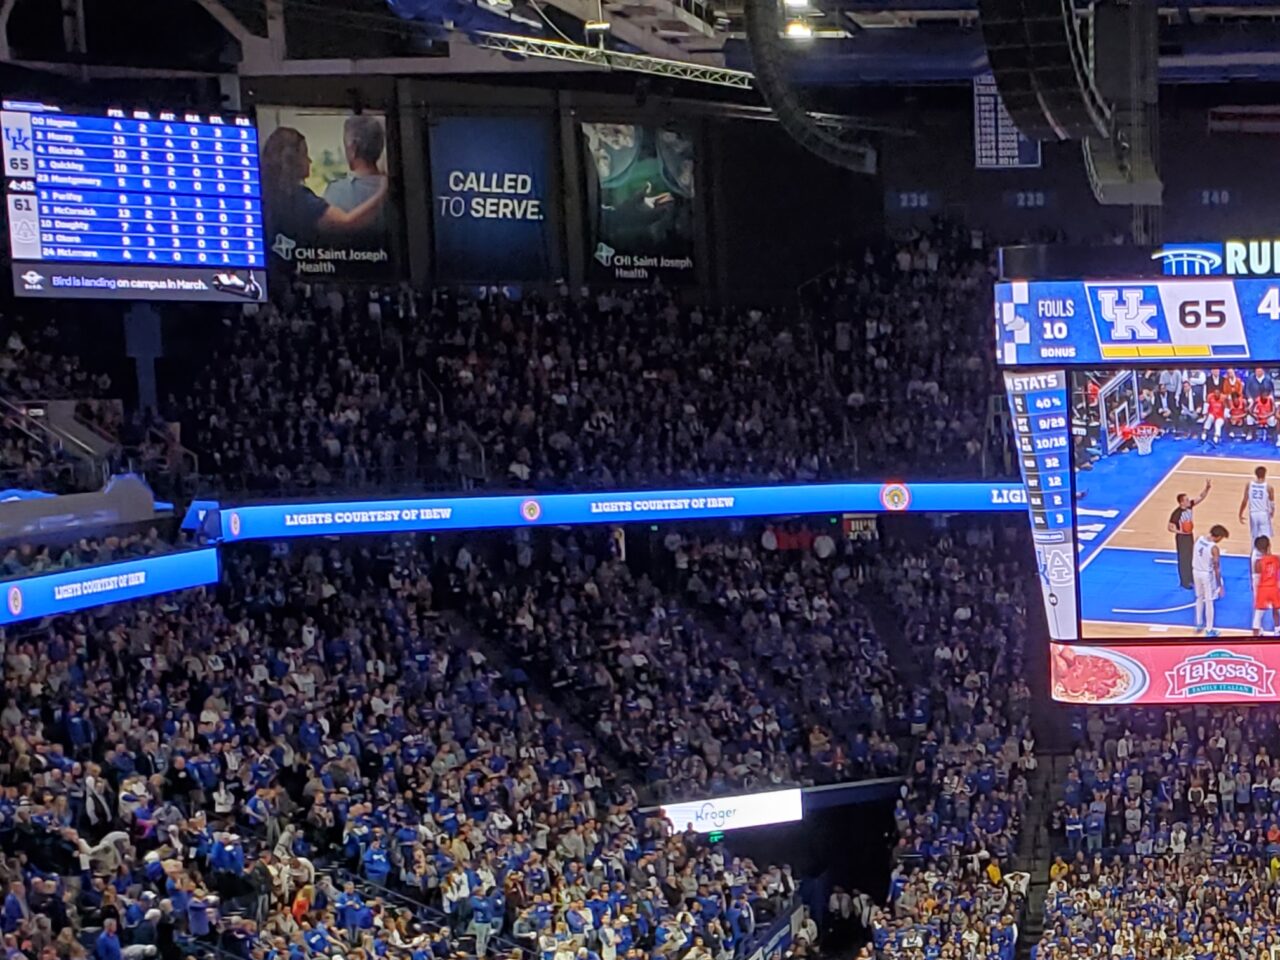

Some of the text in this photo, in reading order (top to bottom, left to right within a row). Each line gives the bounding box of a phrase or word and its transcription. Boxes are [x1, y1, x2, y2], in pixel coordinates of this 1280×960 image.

[9, 158, 29, 170] 65
[8, 180, 35, 192] 4:45
[448, 170, 532, 195] CALLED
[14, 199, 32, 212] 61
[438, 196, 544, 220] TO SERVE.
[295, 248, 388, 266] CHI Saint Joseph
[614, 256, 693, 270] CHI Saint Joseph
[296, 261, 336, 274] Health
[616, 268, 648, 280] Health
[52, 276, 71, 286] Bird
[72, 277, 80, 287] is
[82, 276, 116, 290] landing
[117, 279, 129, 288] on
[130, 279, 166, 290] campus
[177, 279, 209, 290] March.
[1038, 300, 1075, 318] FOULS
[1178, 300, 1227, 330] 65
[1042, 322, 1068, 340] 10
[1040, 347, 1076, 358] BONUS
[1014, 374, 1058, 390] STATS
[1039, 418, 1066, 430] 9/29
[1036, 436, 1067, 450] 10/16
[1045, 457, 1060, 468] 32
[1048, 476, 1062, 487] 12
[590, 496, 735, 513] LIGHTS COURTESY OF IBEW
[1054, 496, 1062, 506] 2
[285, 508, 452, 526] LIGHTS COURTESY OF IBEW
[1056, 514, 1064, 524] 3
[1180, 660, 1259, 684] LaRosa's
[1192, 684, 1218, 694] FAMILY
[696, 802, 737, 828] Kroger
